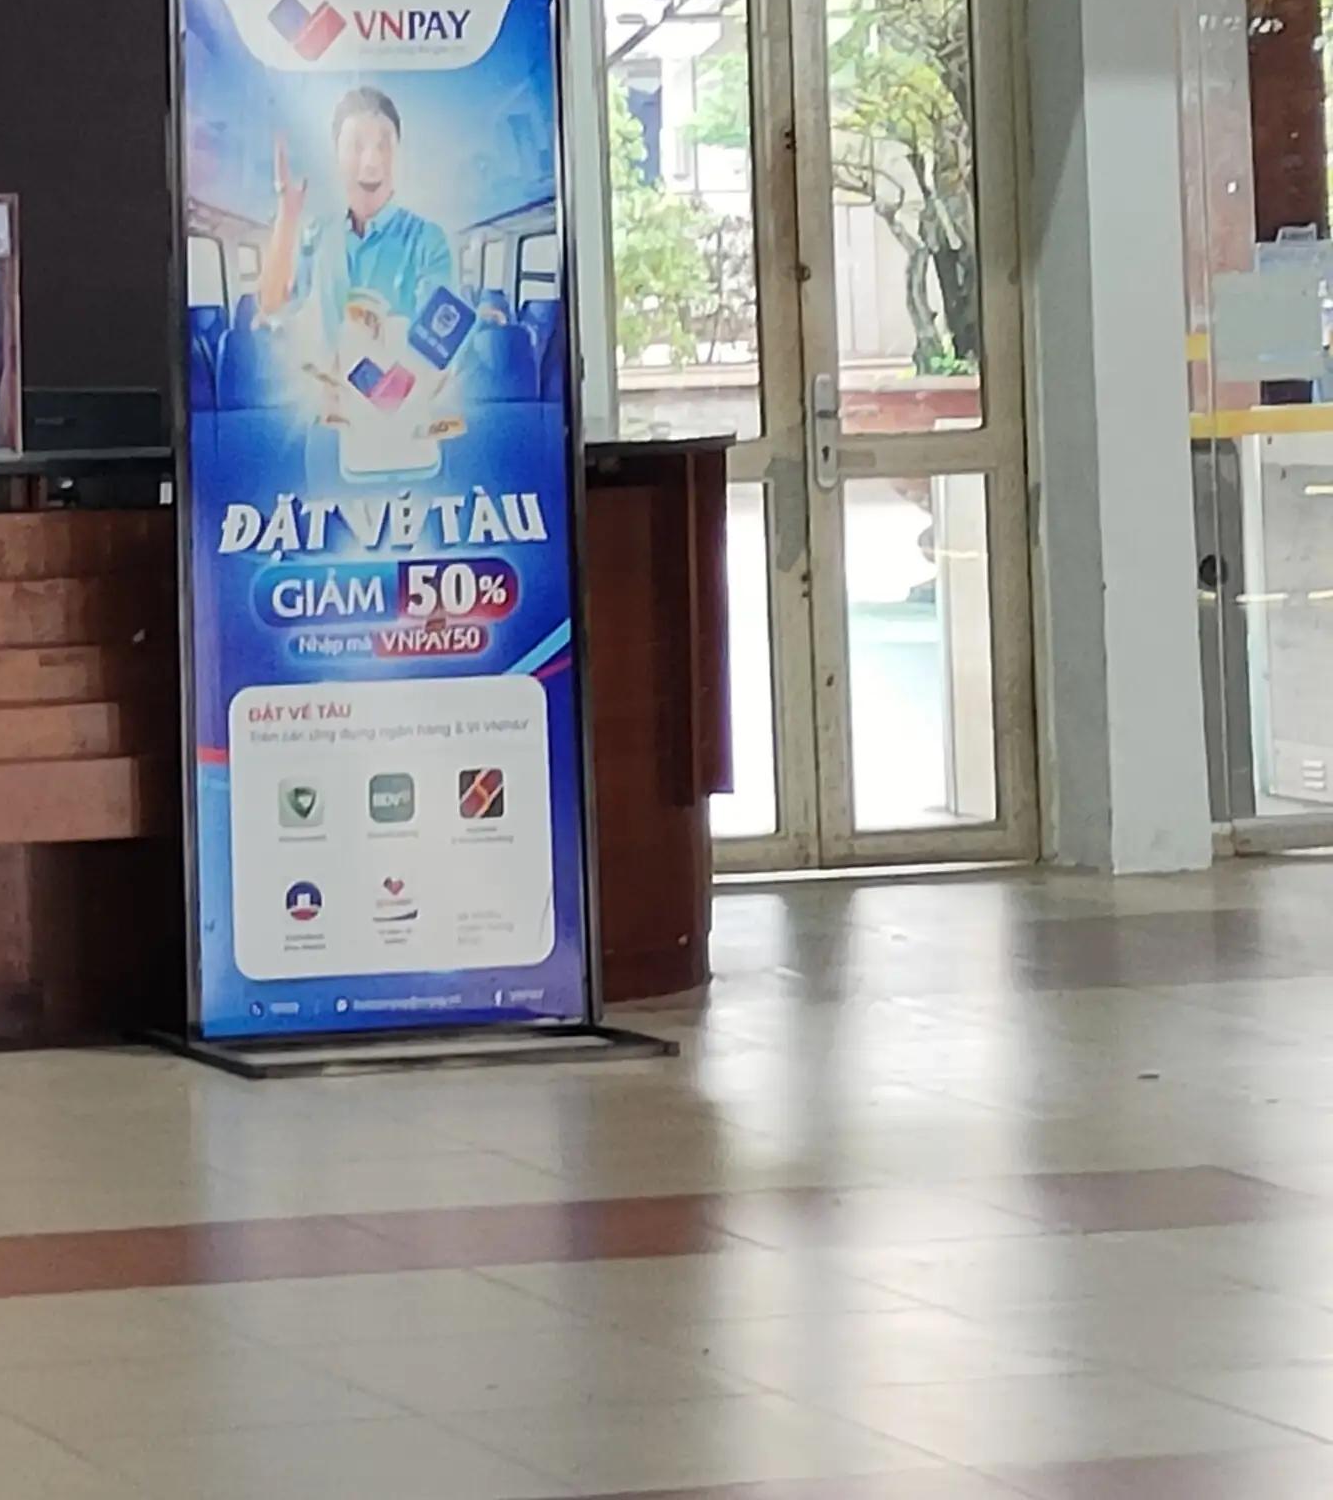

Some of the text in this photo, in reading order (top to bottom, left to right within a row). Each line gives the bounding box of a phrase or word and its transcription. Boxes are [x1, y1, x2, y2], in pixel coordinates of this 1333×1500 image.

[353, 9, 471, 41] VNPAY
[219, 486, 548, 562] ĐẶT VÉ TÀU
[272, 563, 507, 619] GIẢM 50%
[381, 627, 481, 653] VNPAY50
